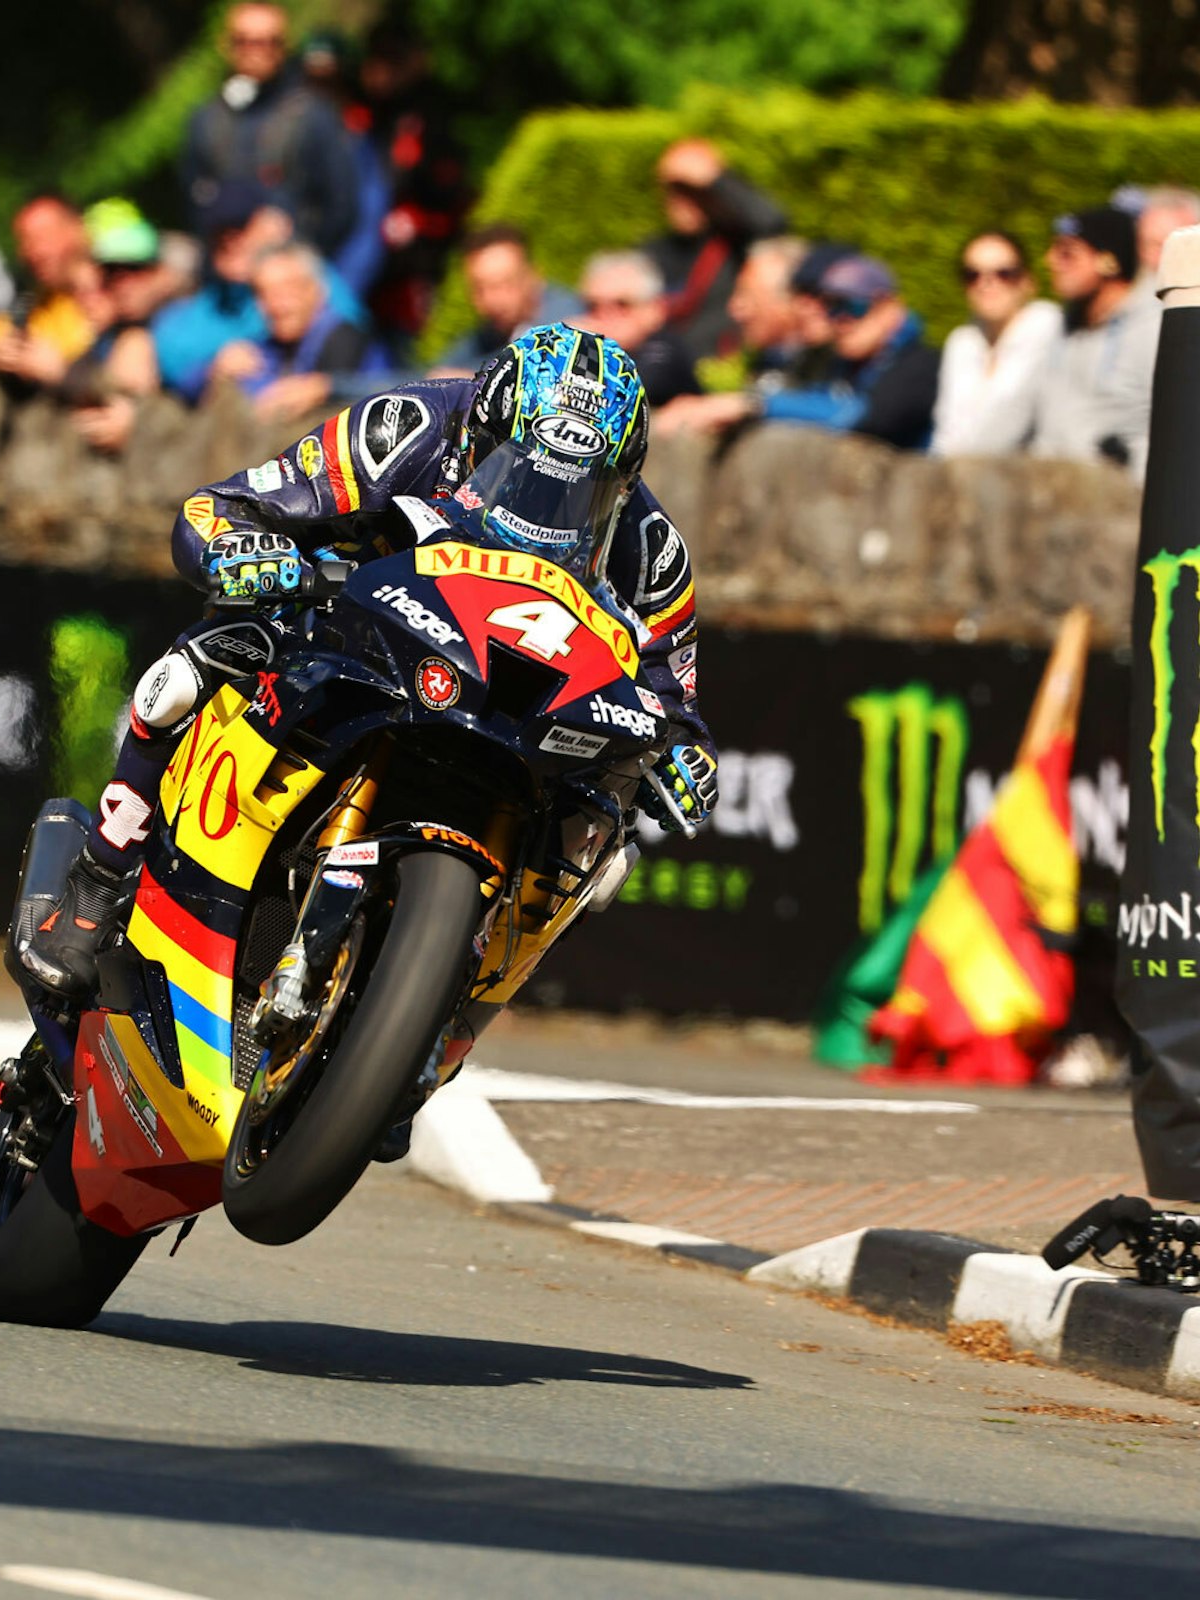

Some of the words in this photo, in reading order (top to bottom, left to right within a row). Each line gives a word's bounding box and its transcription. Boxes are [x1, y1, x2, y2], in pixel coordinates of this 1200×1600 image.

[537, 420, 598, 449] Arai
[533, 461, 580, 484] CONCRETE
[499, 510, 572, 542] Steadplan
[431, 547, 631, 662] MILENCO
[486, 599, 580, 662] 4
[99, 781, 154, 851] 4
[1117, 892, 1200, 948] MON
[186, 1091, 221, 1128] WOODY
